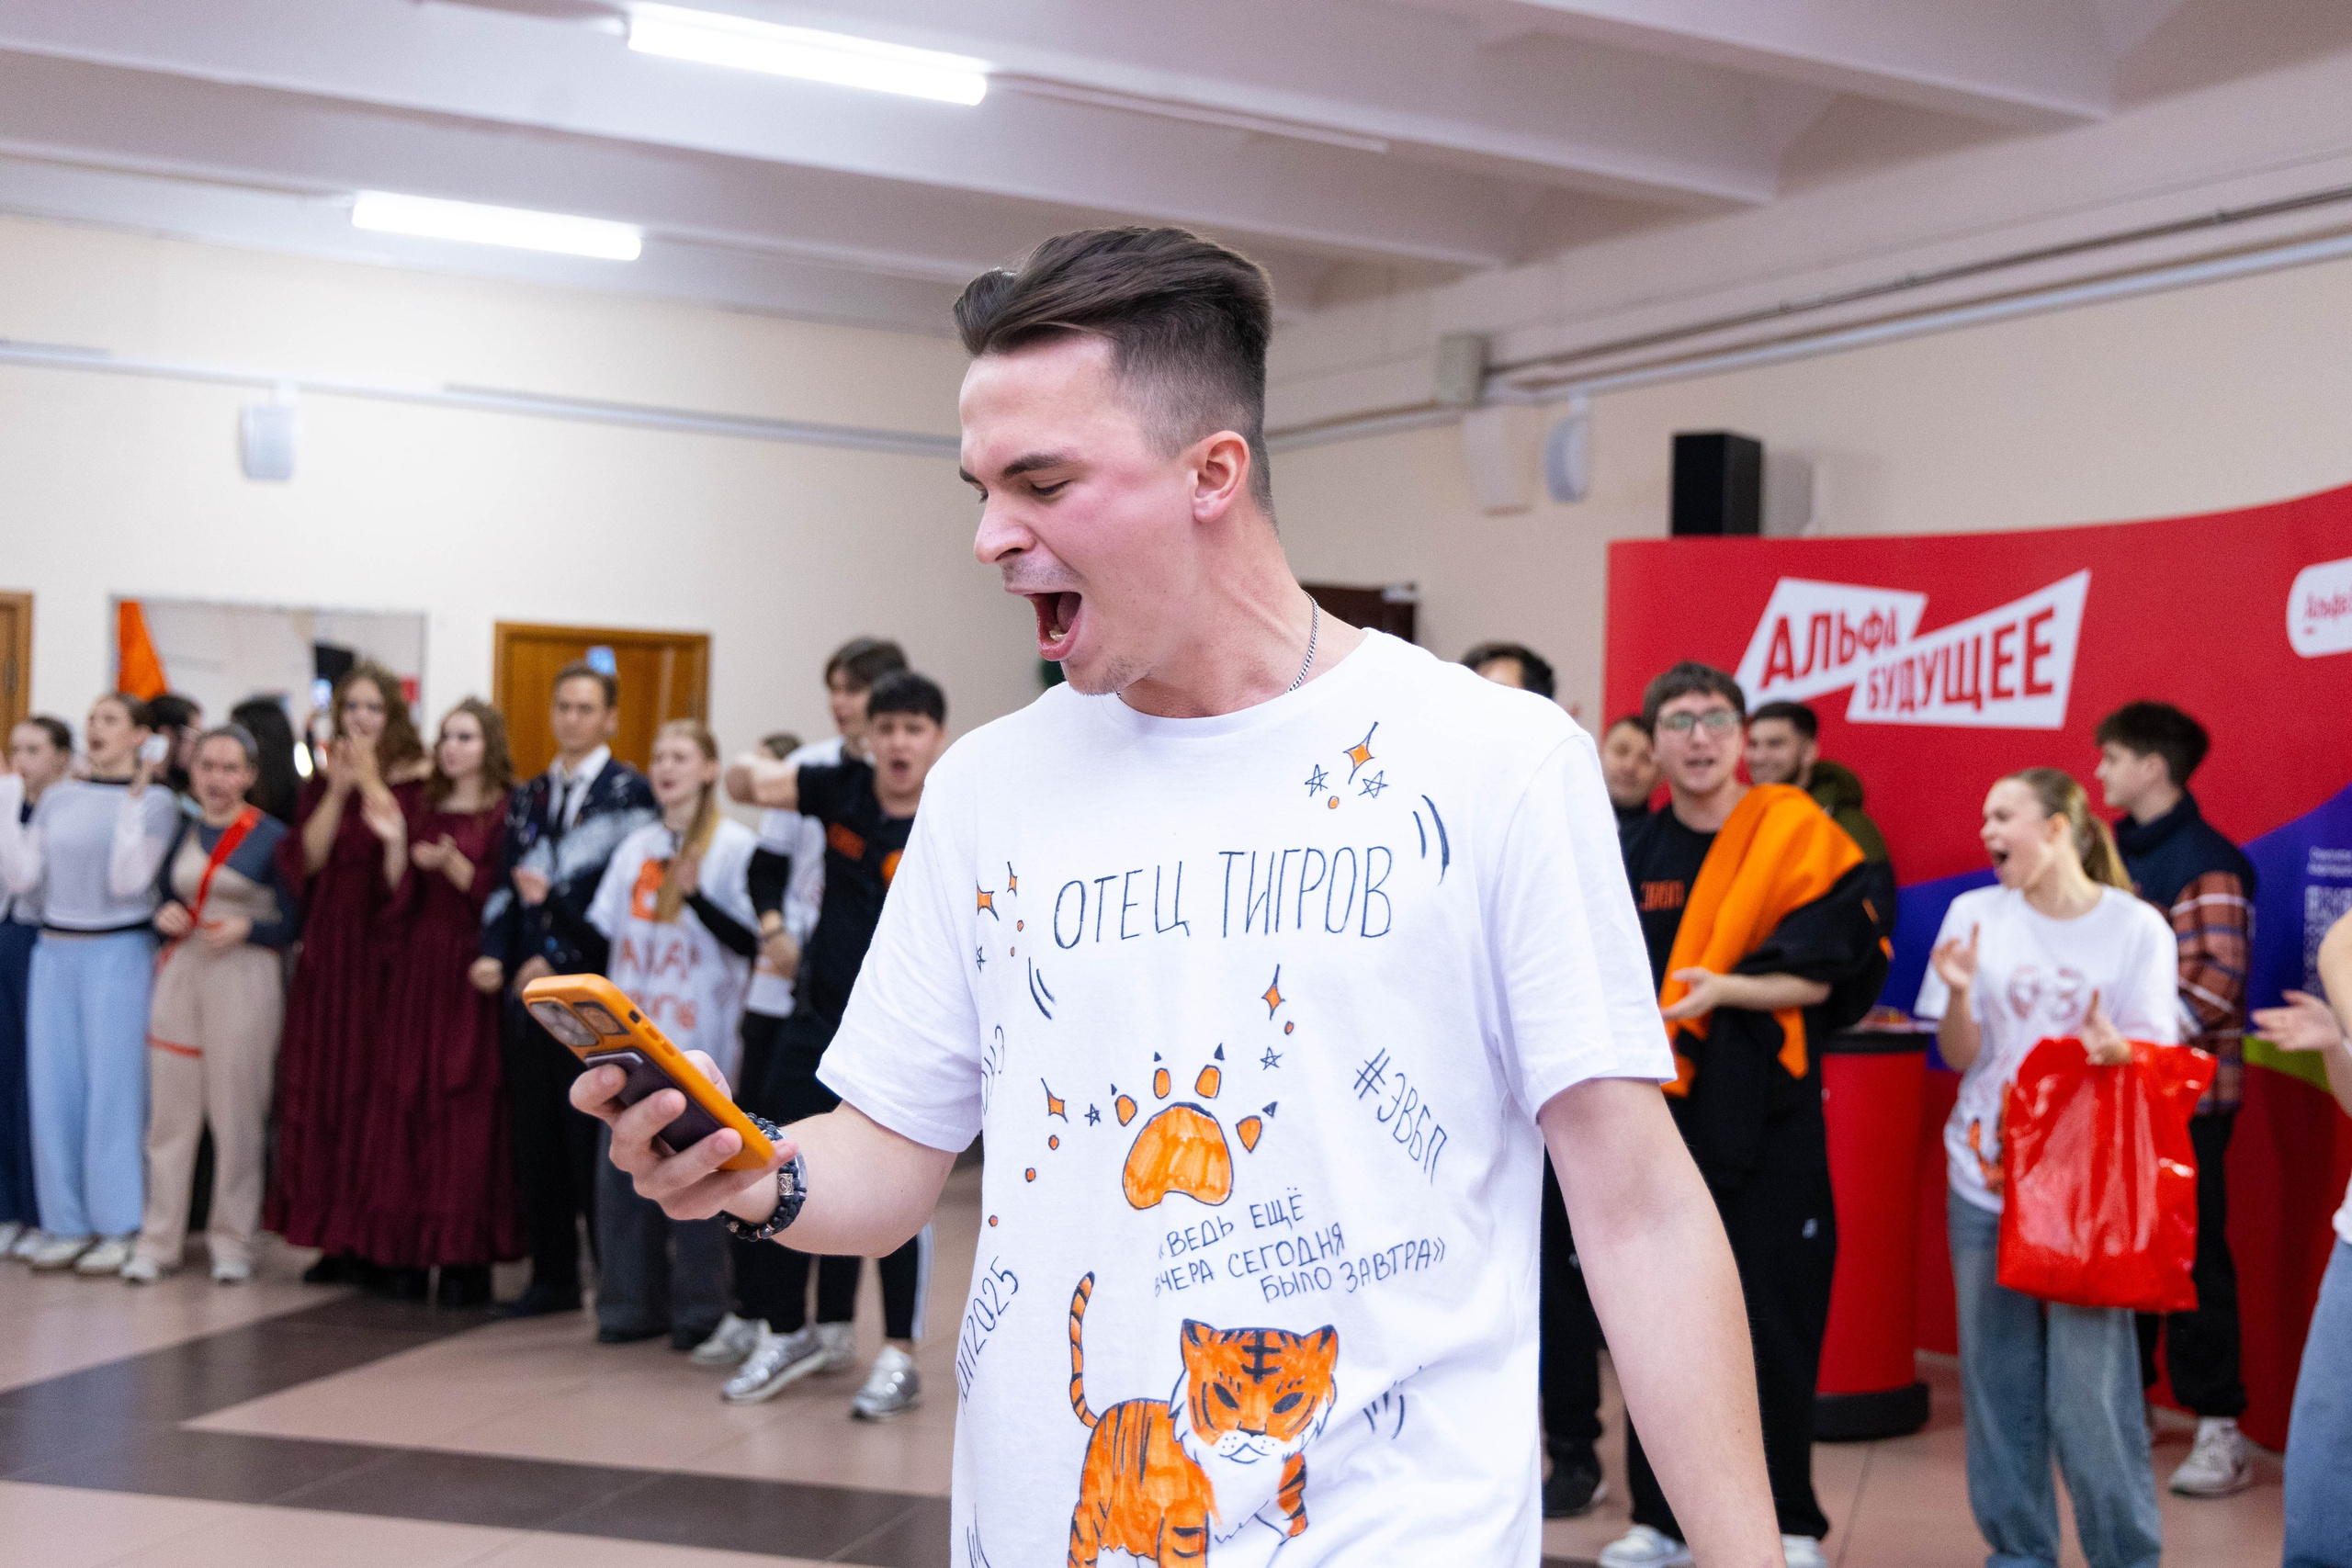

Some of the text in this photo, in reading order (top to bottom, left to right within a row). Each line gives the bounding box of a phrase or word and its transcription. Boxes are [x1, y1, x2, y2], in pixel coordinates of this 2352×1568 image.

[1757, 606, 1897, 691] АЛЬФА
[1867, 605, 2055, 714] БУДУЩЕЕ
[1054, 846, 1393, 950] ОТЕЦ ТИГРОВ
[1250, 1187, 1305, 1231] ЕЩЁ
[1227, 1222, 1346, 1279] СЕГОДНЯ
[1260, 1267, 1332, 1303] БЫЛО
